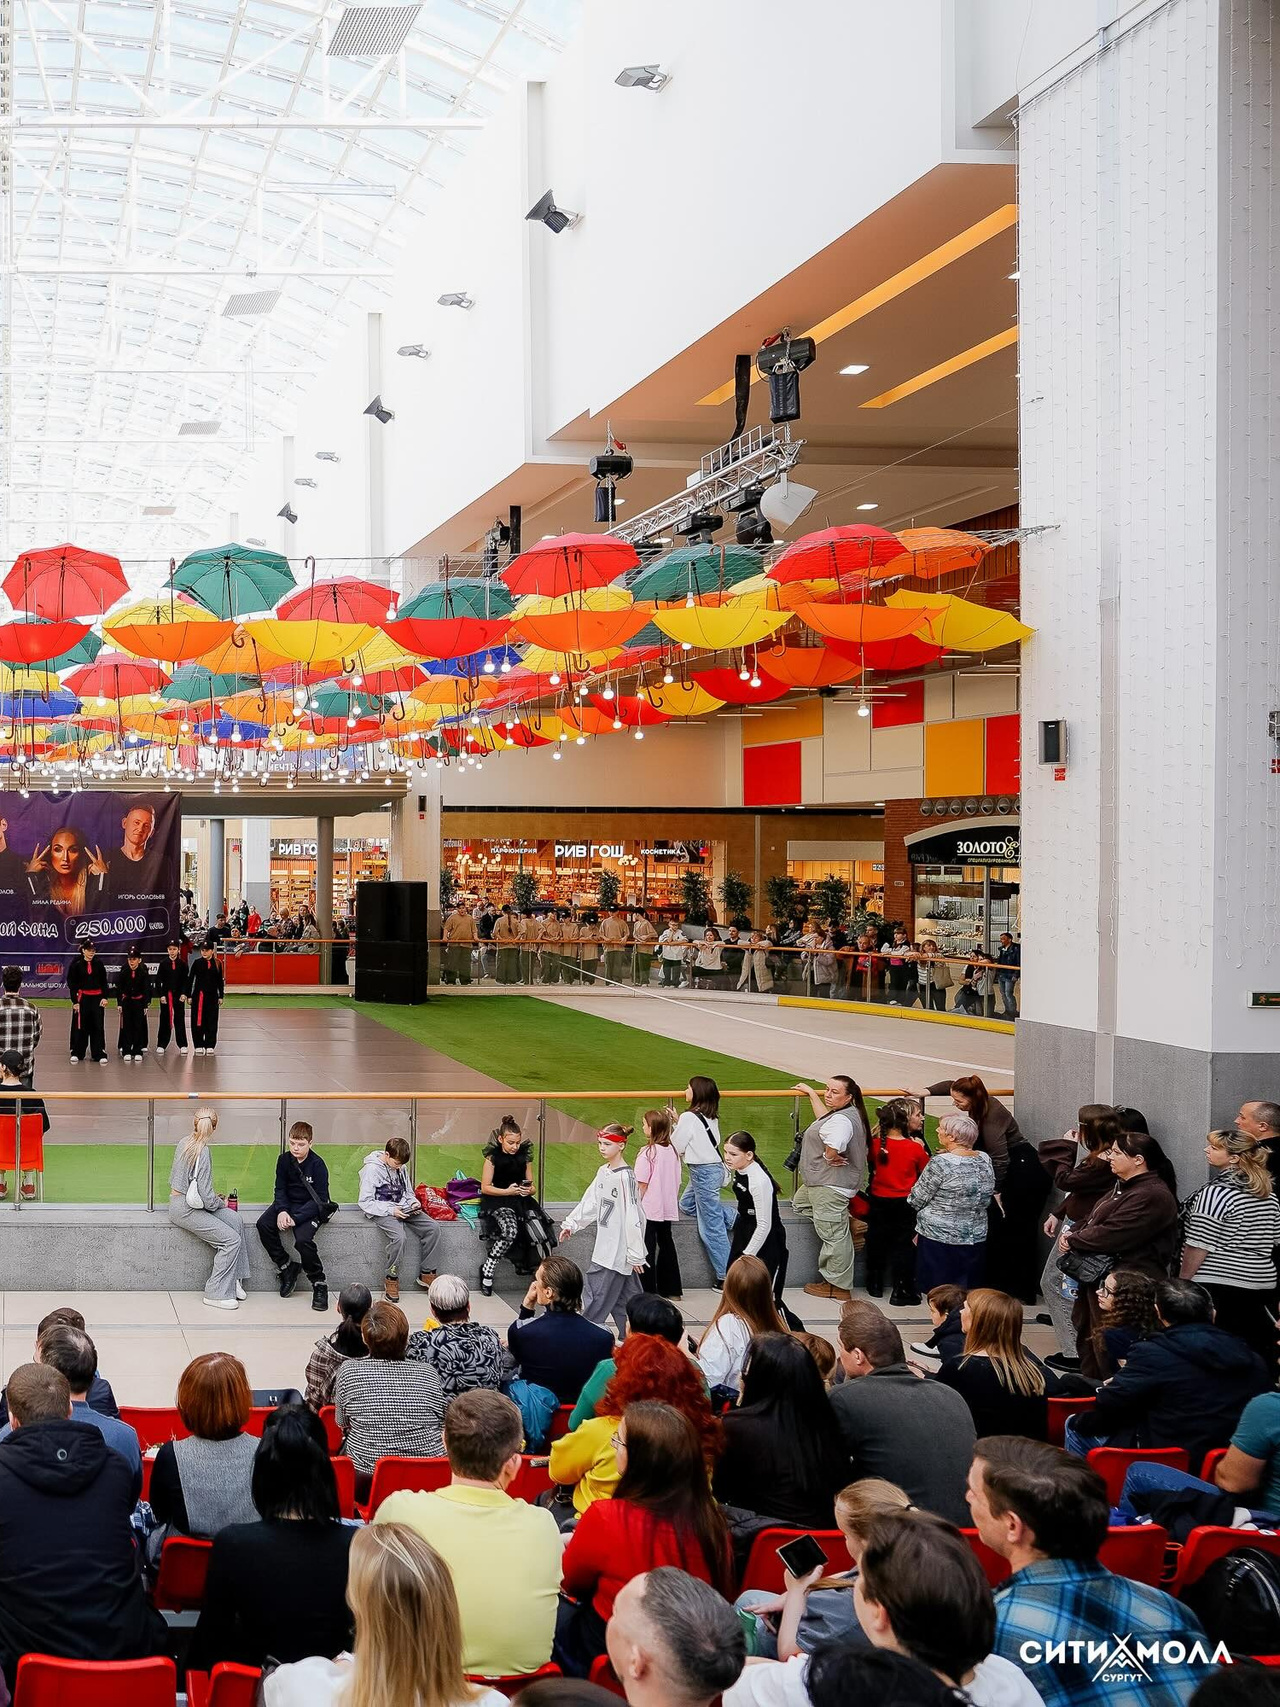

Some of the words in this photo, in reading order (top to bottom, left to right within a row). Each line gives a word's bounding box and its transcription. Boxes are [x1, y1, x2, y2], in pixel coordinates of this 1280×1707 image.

[279, 843, 301, 855] РИВ
[303, 843, 318, 855] ГО
[554, 845, 587, 858] РИВ
[590, 845, 624, 858] ГОШ
[956, 841, 1006, 854] ЗОЛОТО
[18, 921, 59, 938] ФОНД
[74, 915, 147, 939] 250.000
